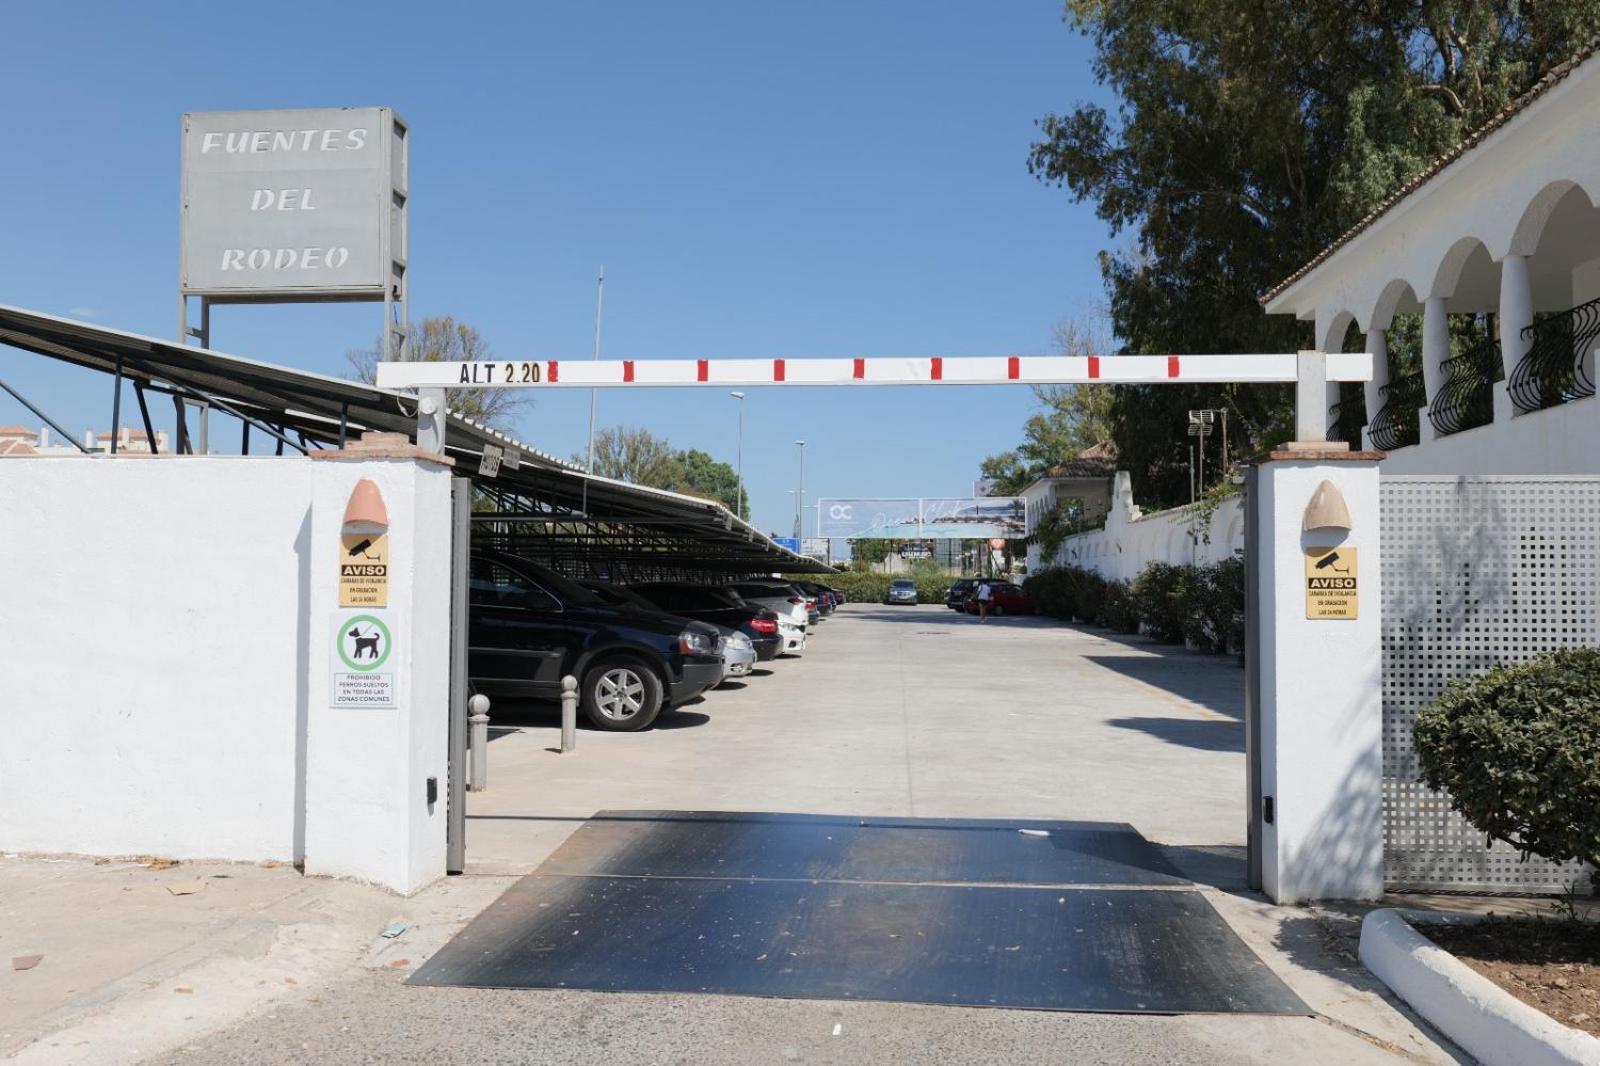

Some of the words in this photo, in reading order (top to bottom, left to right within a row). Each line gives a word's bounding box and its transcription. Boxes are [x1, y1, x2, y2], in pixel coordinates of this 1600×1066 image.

[201, 128, 368, 154] FUENTES
[250, 188, 317, 211] DEL
[220, 247, 349, 272] RODEO
[460, 363, 495, 384] ALT
[505, 362, 541, 383] 2.20
[343, 565, 385, 576] AVISO
[1311, 578, 1354, 588] AVISO
